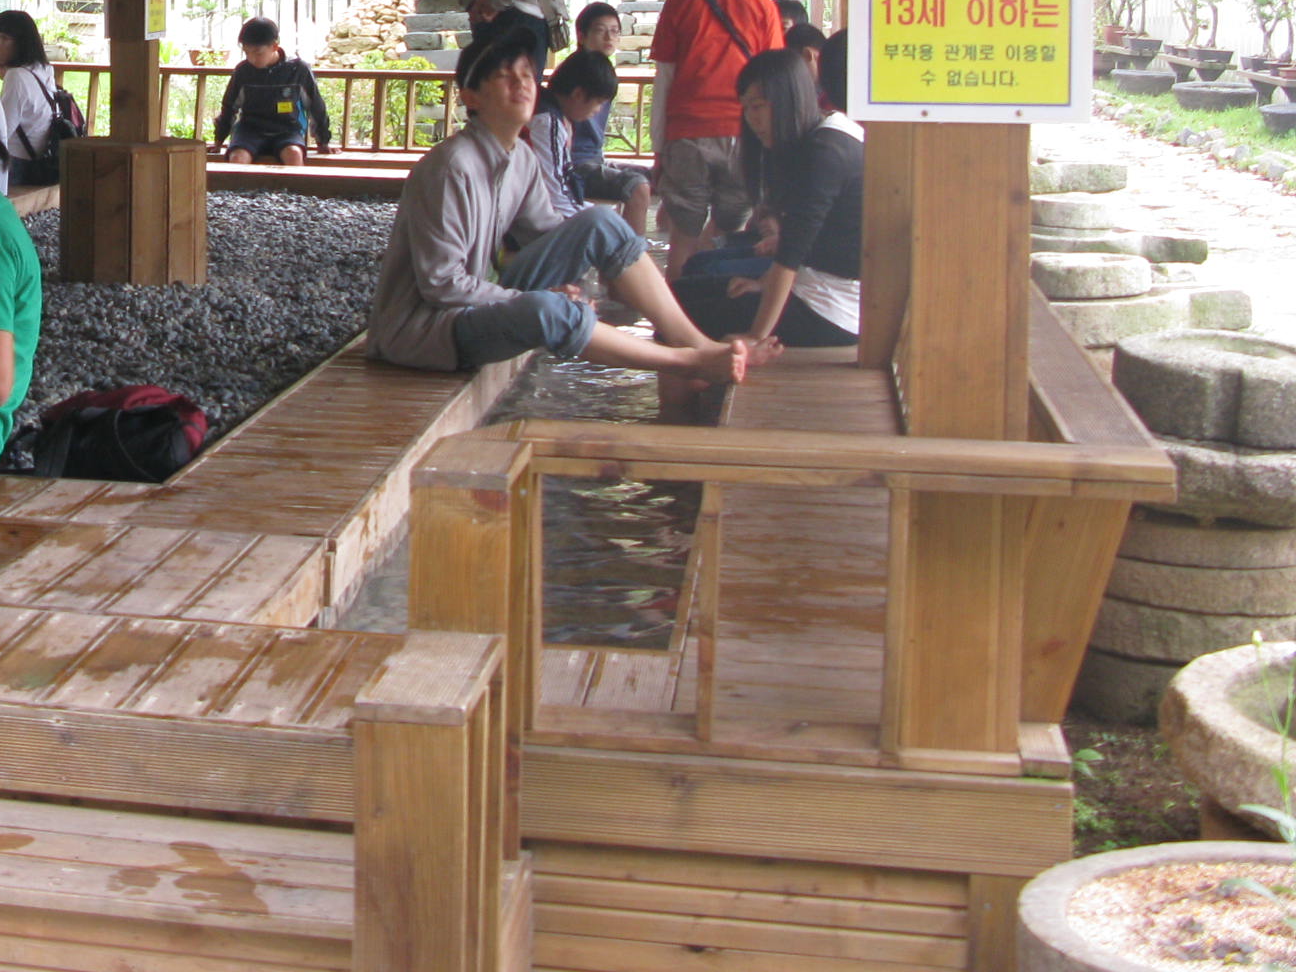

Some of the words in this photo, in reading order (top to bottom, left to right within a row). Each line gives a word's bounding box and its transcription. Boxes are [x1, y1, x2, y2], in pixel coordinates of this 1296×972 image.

[884, 43, 934, 62] 부작용
[944, 44, 995, 62] 관계로
[1005, 44, 1057, 62] 이용할
[920, 70, 936, 87] 수
[947, 69, 1019, 88] 없습니다.
